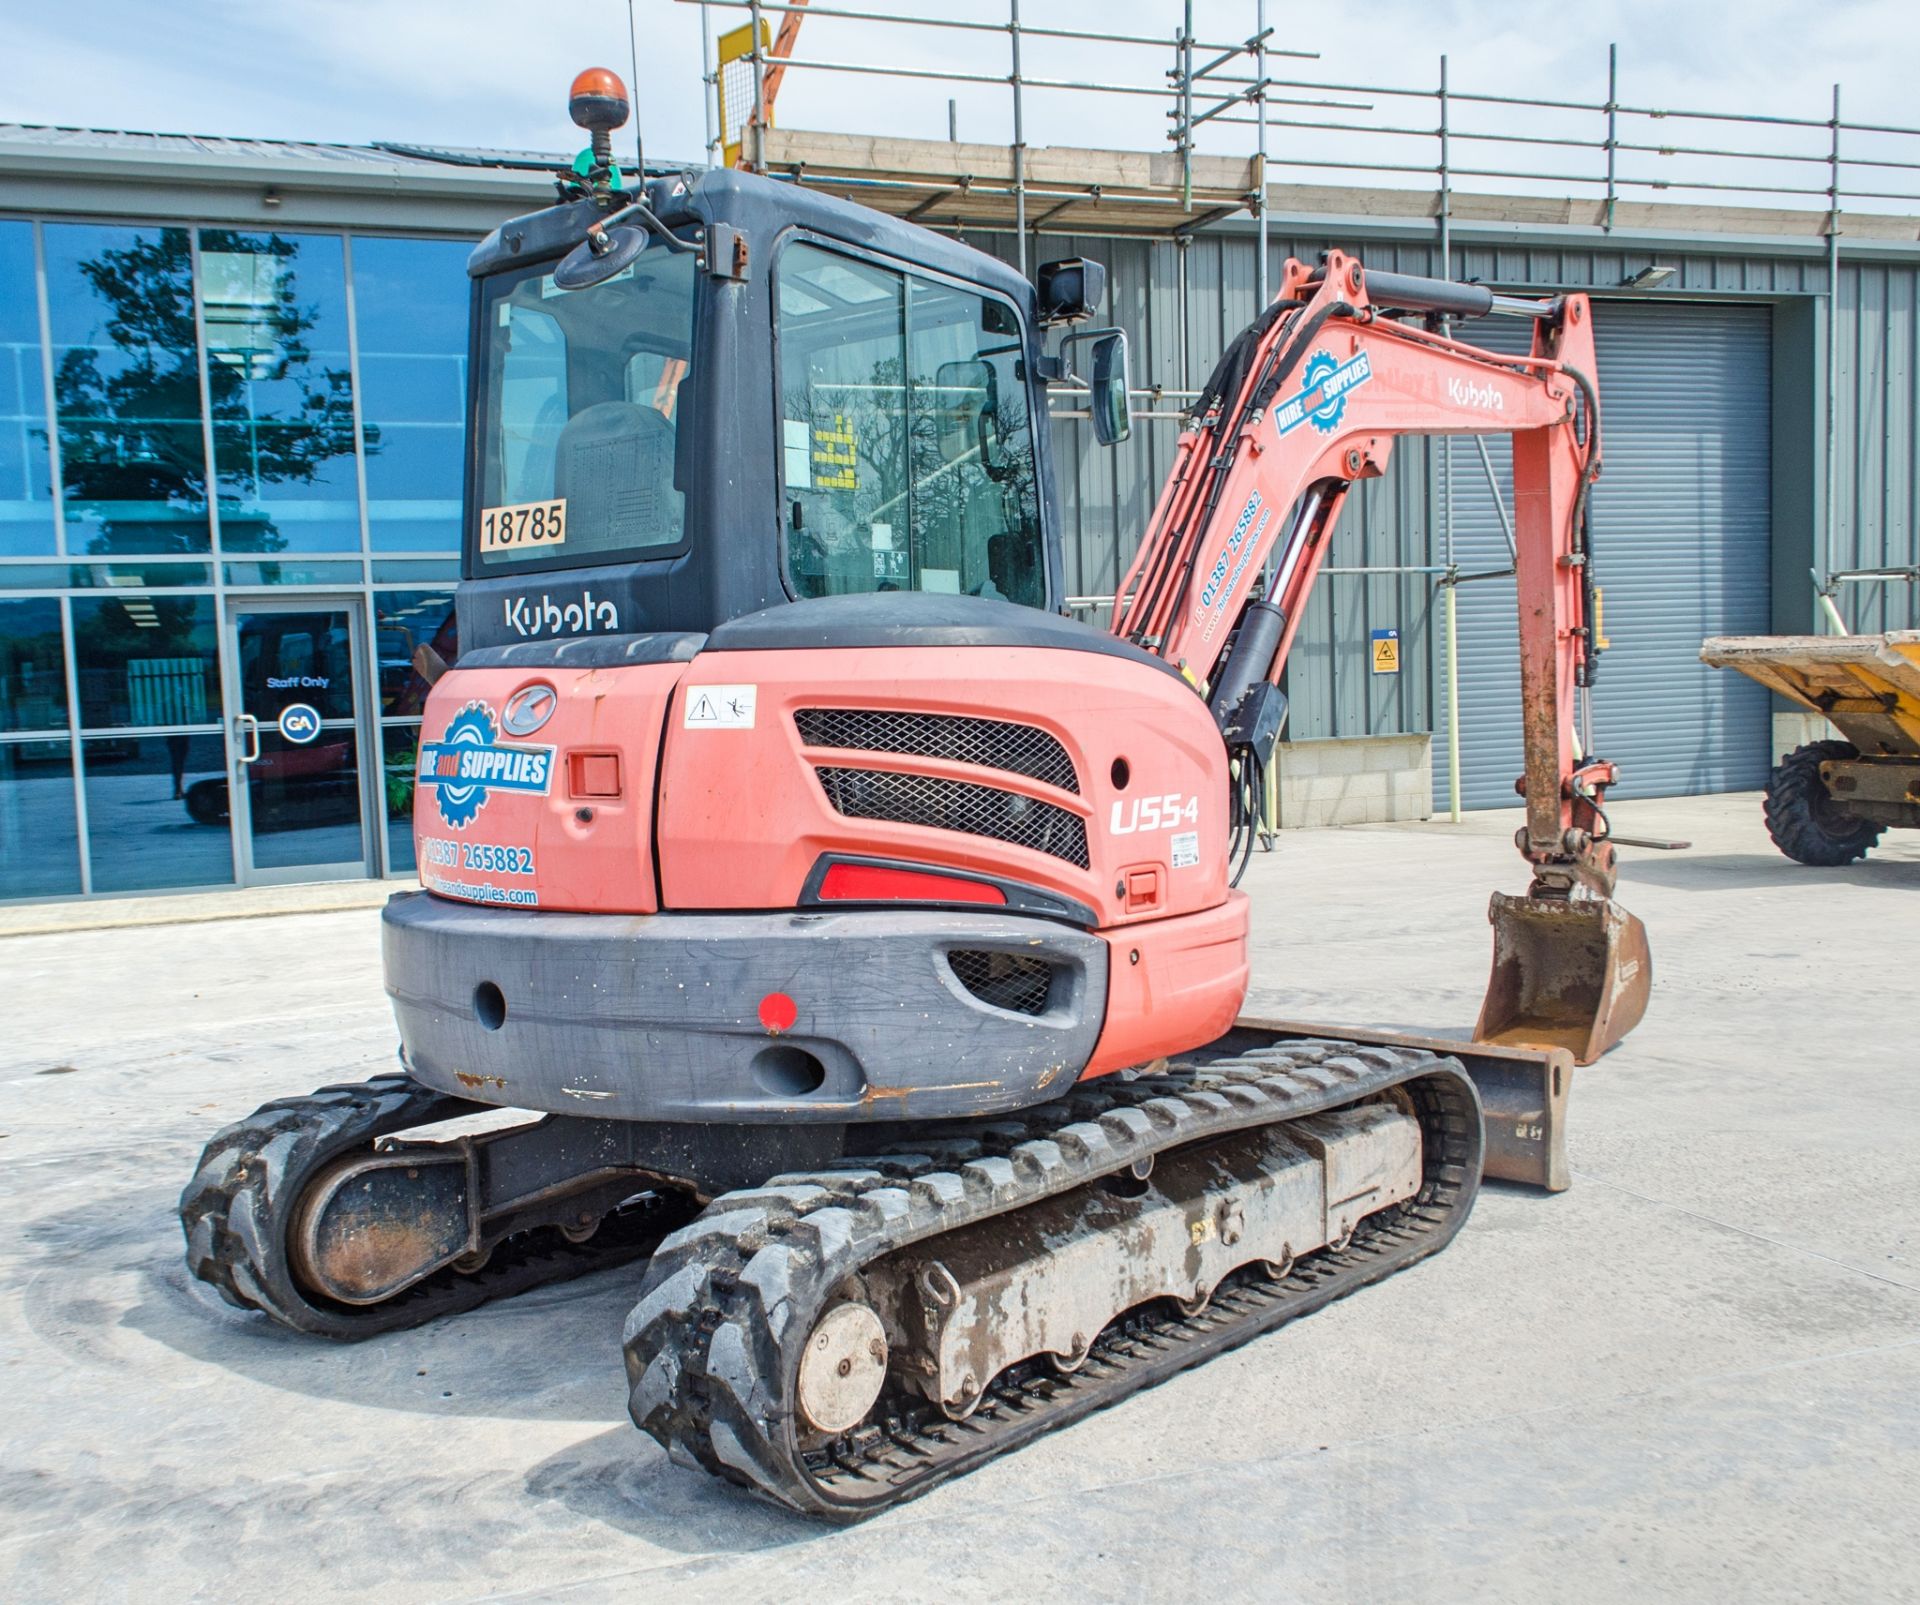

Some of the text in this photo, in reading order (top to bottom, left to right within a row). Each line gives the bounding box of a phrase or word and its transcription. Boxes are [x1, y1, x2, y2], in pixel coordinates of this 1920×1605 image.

[1277, 398, 1304, 430] HIRE
[1322, 356, 1369, 400] SUPPLIES
[1448, 377, 1504, 410] Kubota
[485, 504, 562, 546] 18785
[1201, 549, 1231, 608] 01387
[1228, 490, 1263, 554] 265882
[1203, 507, 1271, 642] www.hireandsupplies.com
[504, 591, 619, 636] Kubota
[266, 675, 330, 688] Staff Only
[286, 716, 314, 731] GA
[436, 751, 461, 777] and
[460, 750, 547, 784] SUPPLIES
[462, 843, 535, 875] 265882
